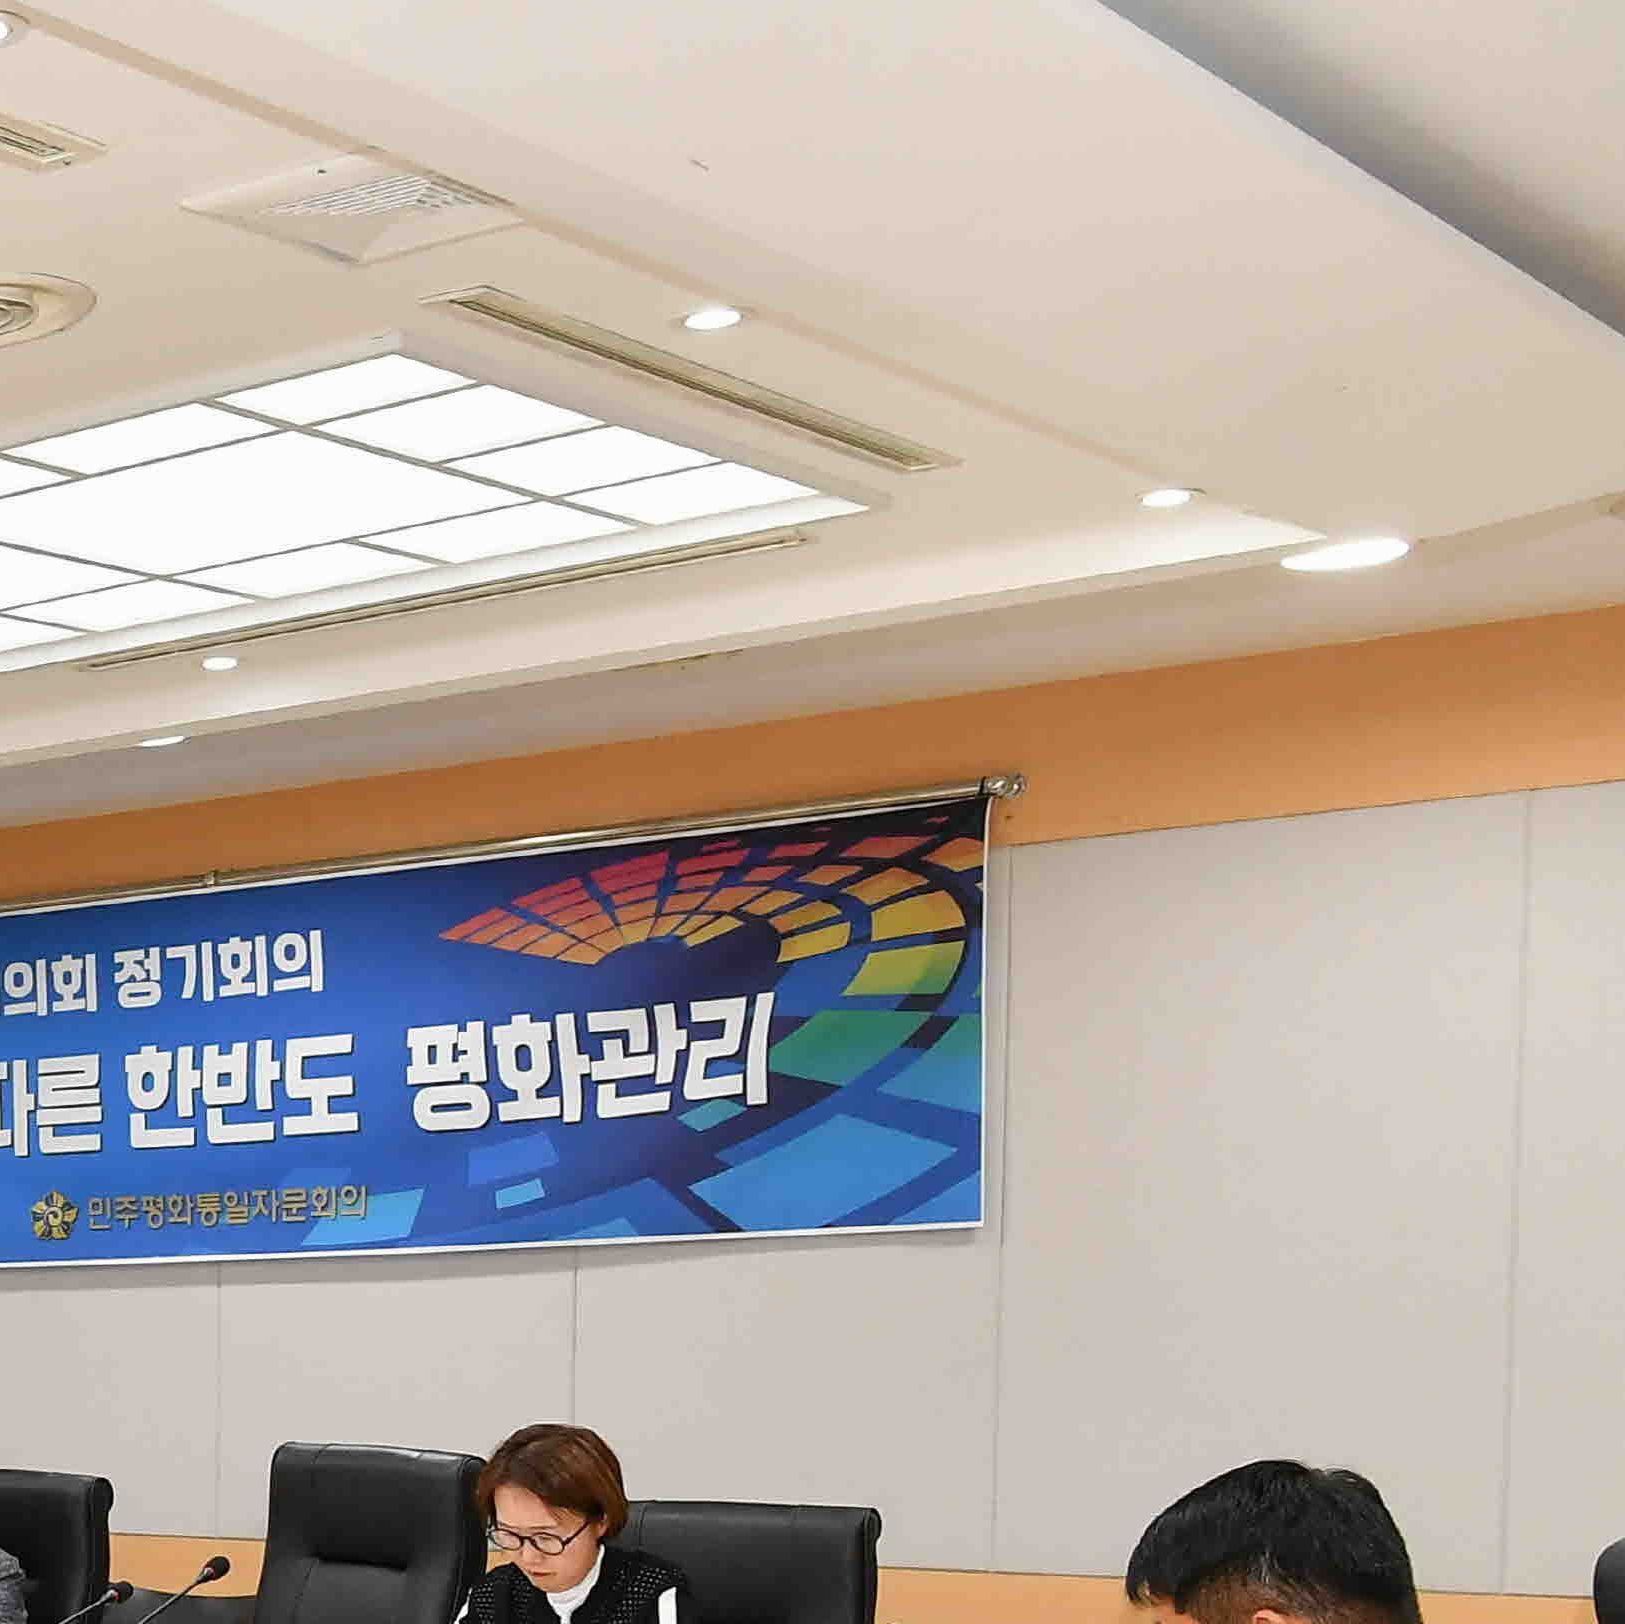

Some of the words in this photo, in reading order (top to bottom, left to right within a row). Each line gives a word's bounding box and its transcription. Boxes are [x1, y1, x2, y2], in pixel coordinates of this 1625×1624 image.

[113, 929, 324, 1010] 정기회의
[125, 1033, 361, 1149] 한반도
[406, 992, 776, 1132] 평화관리
[87, 1184, 368, 1231] 민주평화통일자문회의
